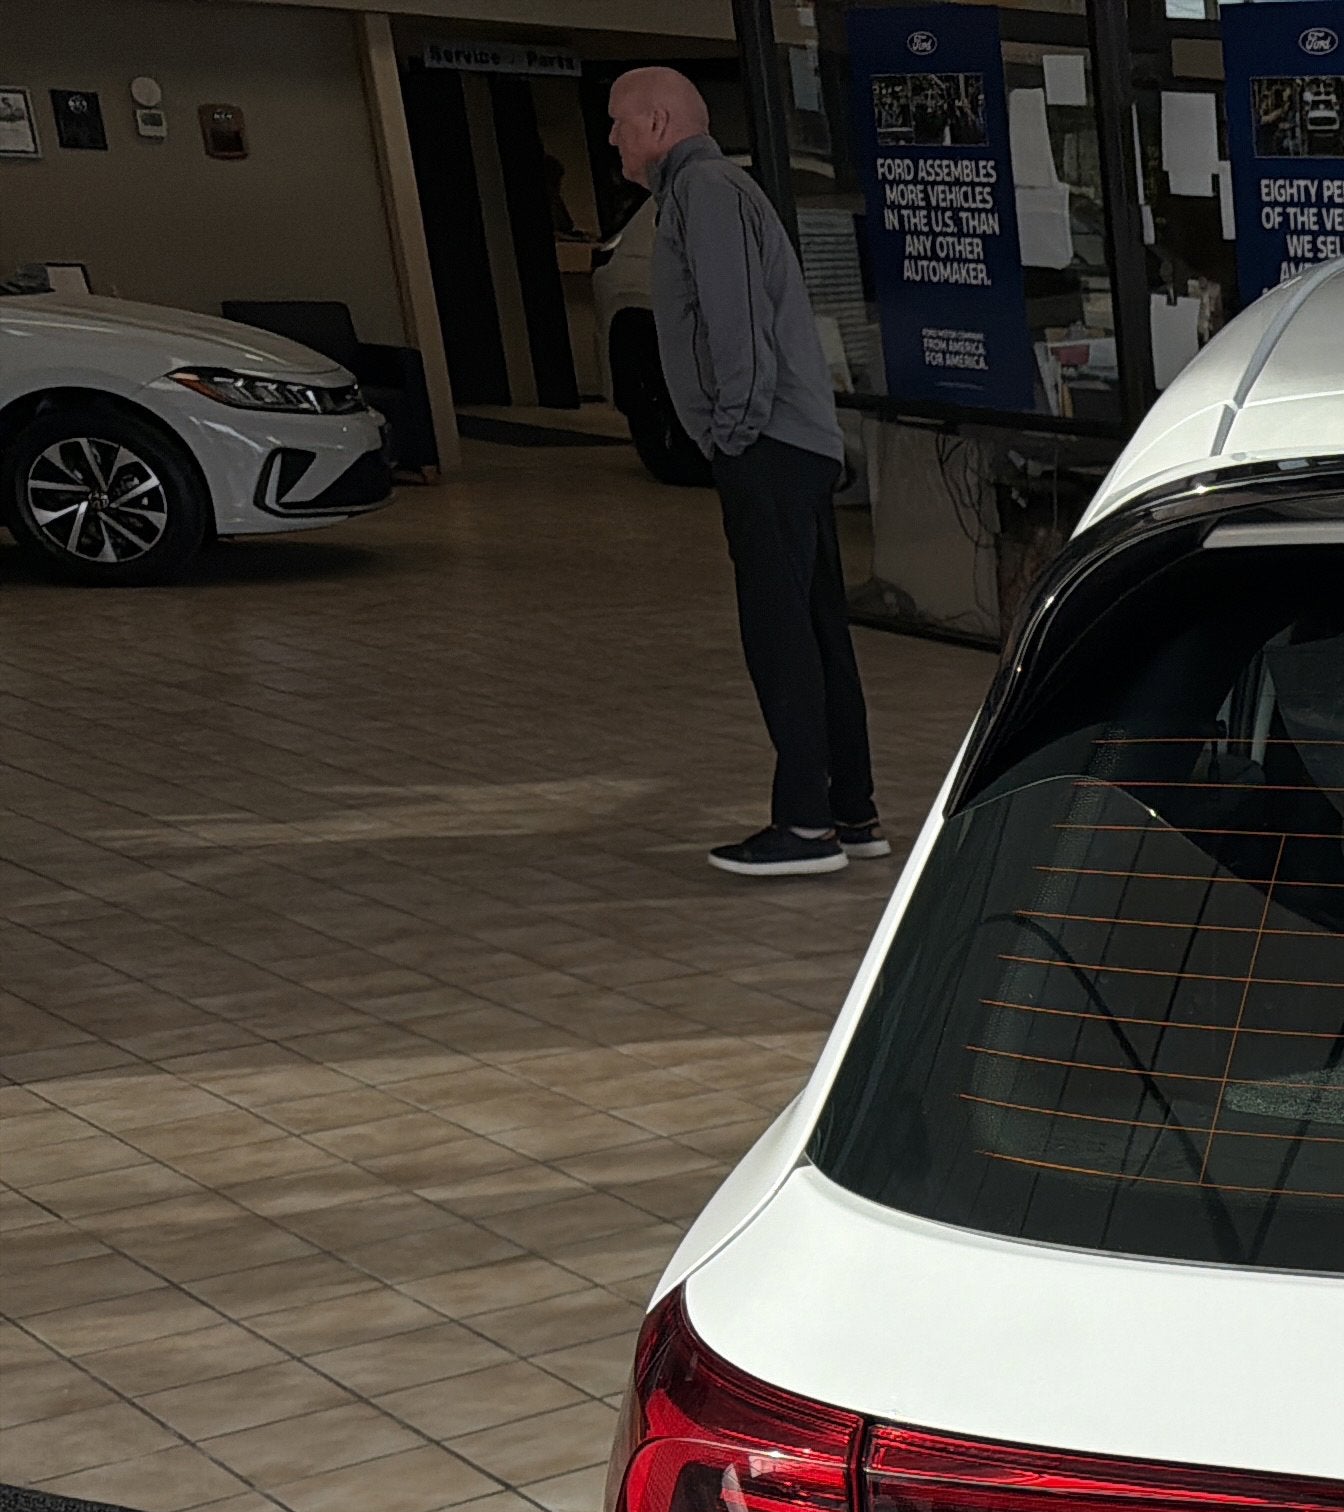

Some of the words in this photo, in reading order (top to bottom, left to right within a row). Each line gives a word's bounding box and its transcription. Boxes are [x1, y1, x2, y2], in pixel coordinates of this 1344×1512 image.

[430, 46, 500, 65] Service
[877, 158, 914, 181] FORD
[917, 158, 997, 183] ASSEMBLES
[885, 184, 925, 207] MORE
[928, 184, 993, 209] VEHICLES
[1260, 179, 1319, 203] EIGHTY
[884, 208, 900, 231] IN
[901, 209, 929, 232] THE
[931, 210, 957, 233] U.S.
[960, 211, 1000, 235] THAN
[1261, 206, 1284, 230] OF
[1285, 206, 1319, 231] THE
[905, 235, 932, 257] ANY
[935, 236, 984, 260] OTHER
[1286, 234, 1314, 258] WE
[903, 259, 992, 286] AUTOMAKER.
[923, 337, 947, 351] FROM
[924, 351, 945, 366] FOR
